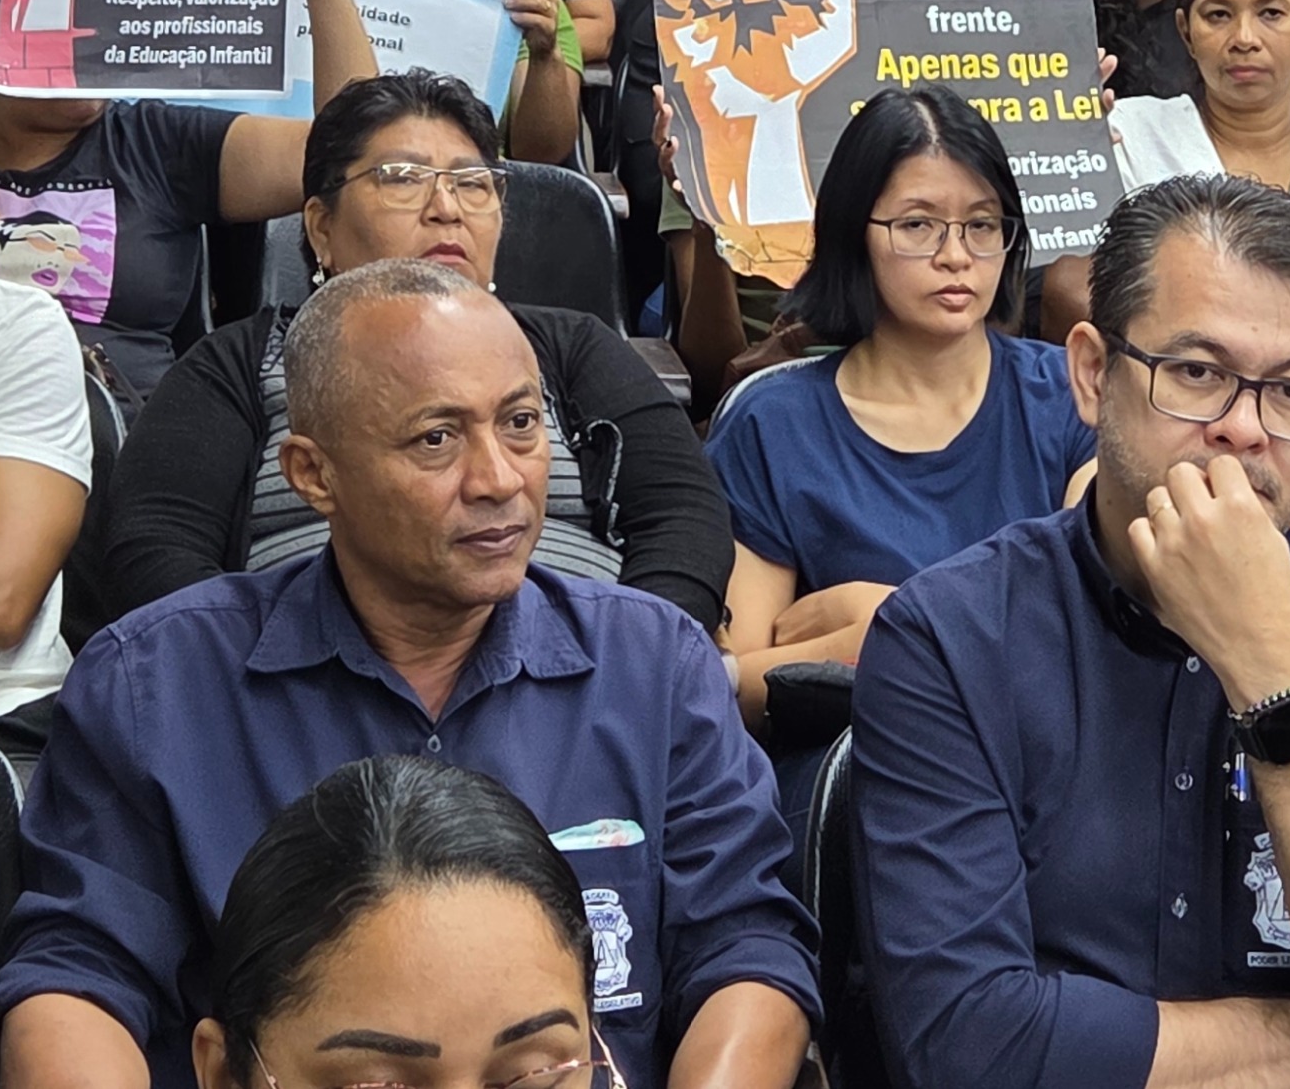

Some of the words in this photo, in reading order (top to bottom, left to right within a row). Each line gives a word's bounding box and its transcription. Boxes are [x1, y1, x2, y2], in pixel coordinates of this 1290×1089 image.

[119, 18, 151, 35] aos
[153, 15, 264, 39] profissionais
[926, 6, 1020, 35] frente,
[105, 46, 126, 64] da
[128, 45, 207, 69] Educação
[210, 45, 272, 65] Infantil
[876, 48, 1000, 88] Apenas
[1007, 50, 1069, 87] que
[1029, 96, 1049, 122] a
[1054, 87, 1103, 120] Lei
